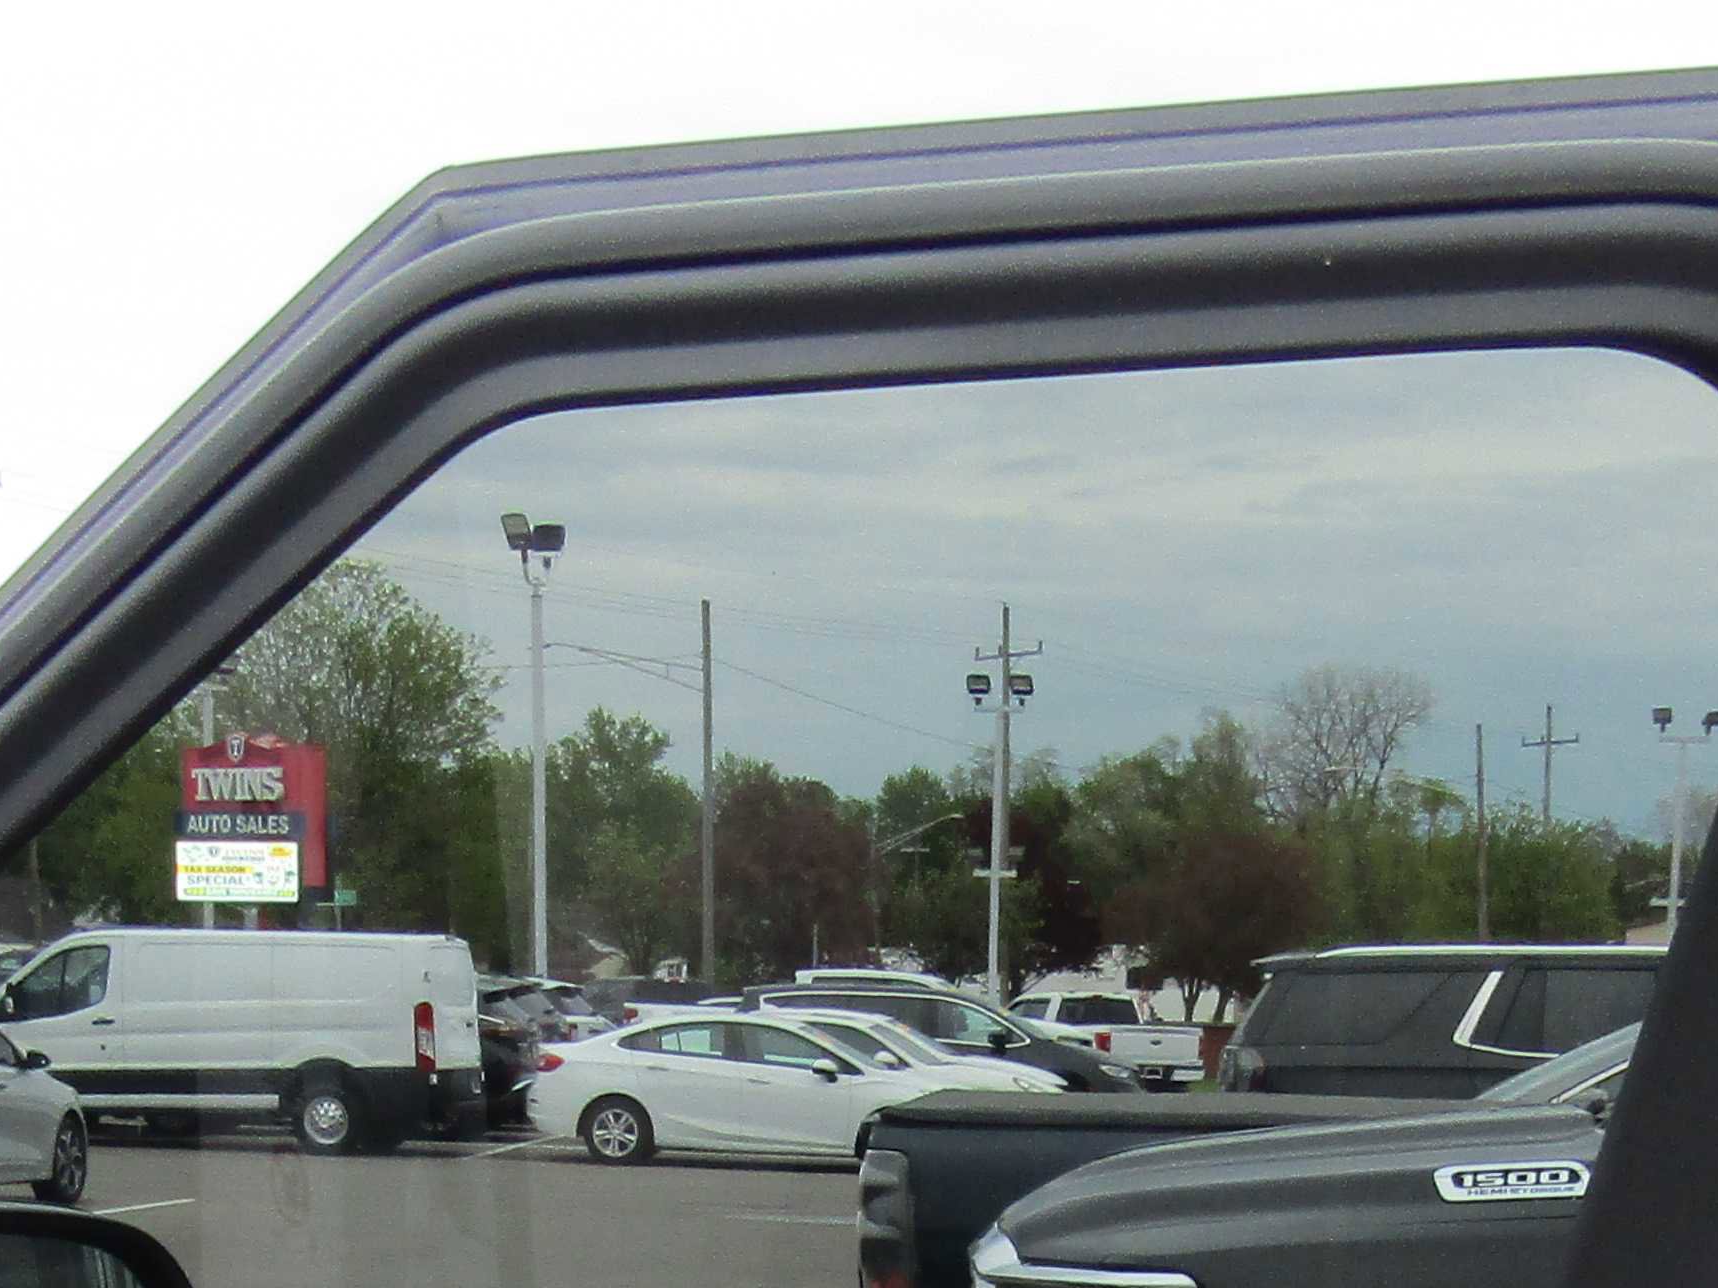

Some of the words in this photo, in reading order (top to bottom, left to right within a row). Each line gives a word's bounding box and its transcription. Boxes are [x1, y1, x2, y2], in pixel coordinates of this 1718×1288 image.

[192, 767, 285, 800] TWINS
[187, 815, 231, 834] AUTO
[235, 815, 290, 834] SALES
[1462, 1170, 1569, 1187] 1500
